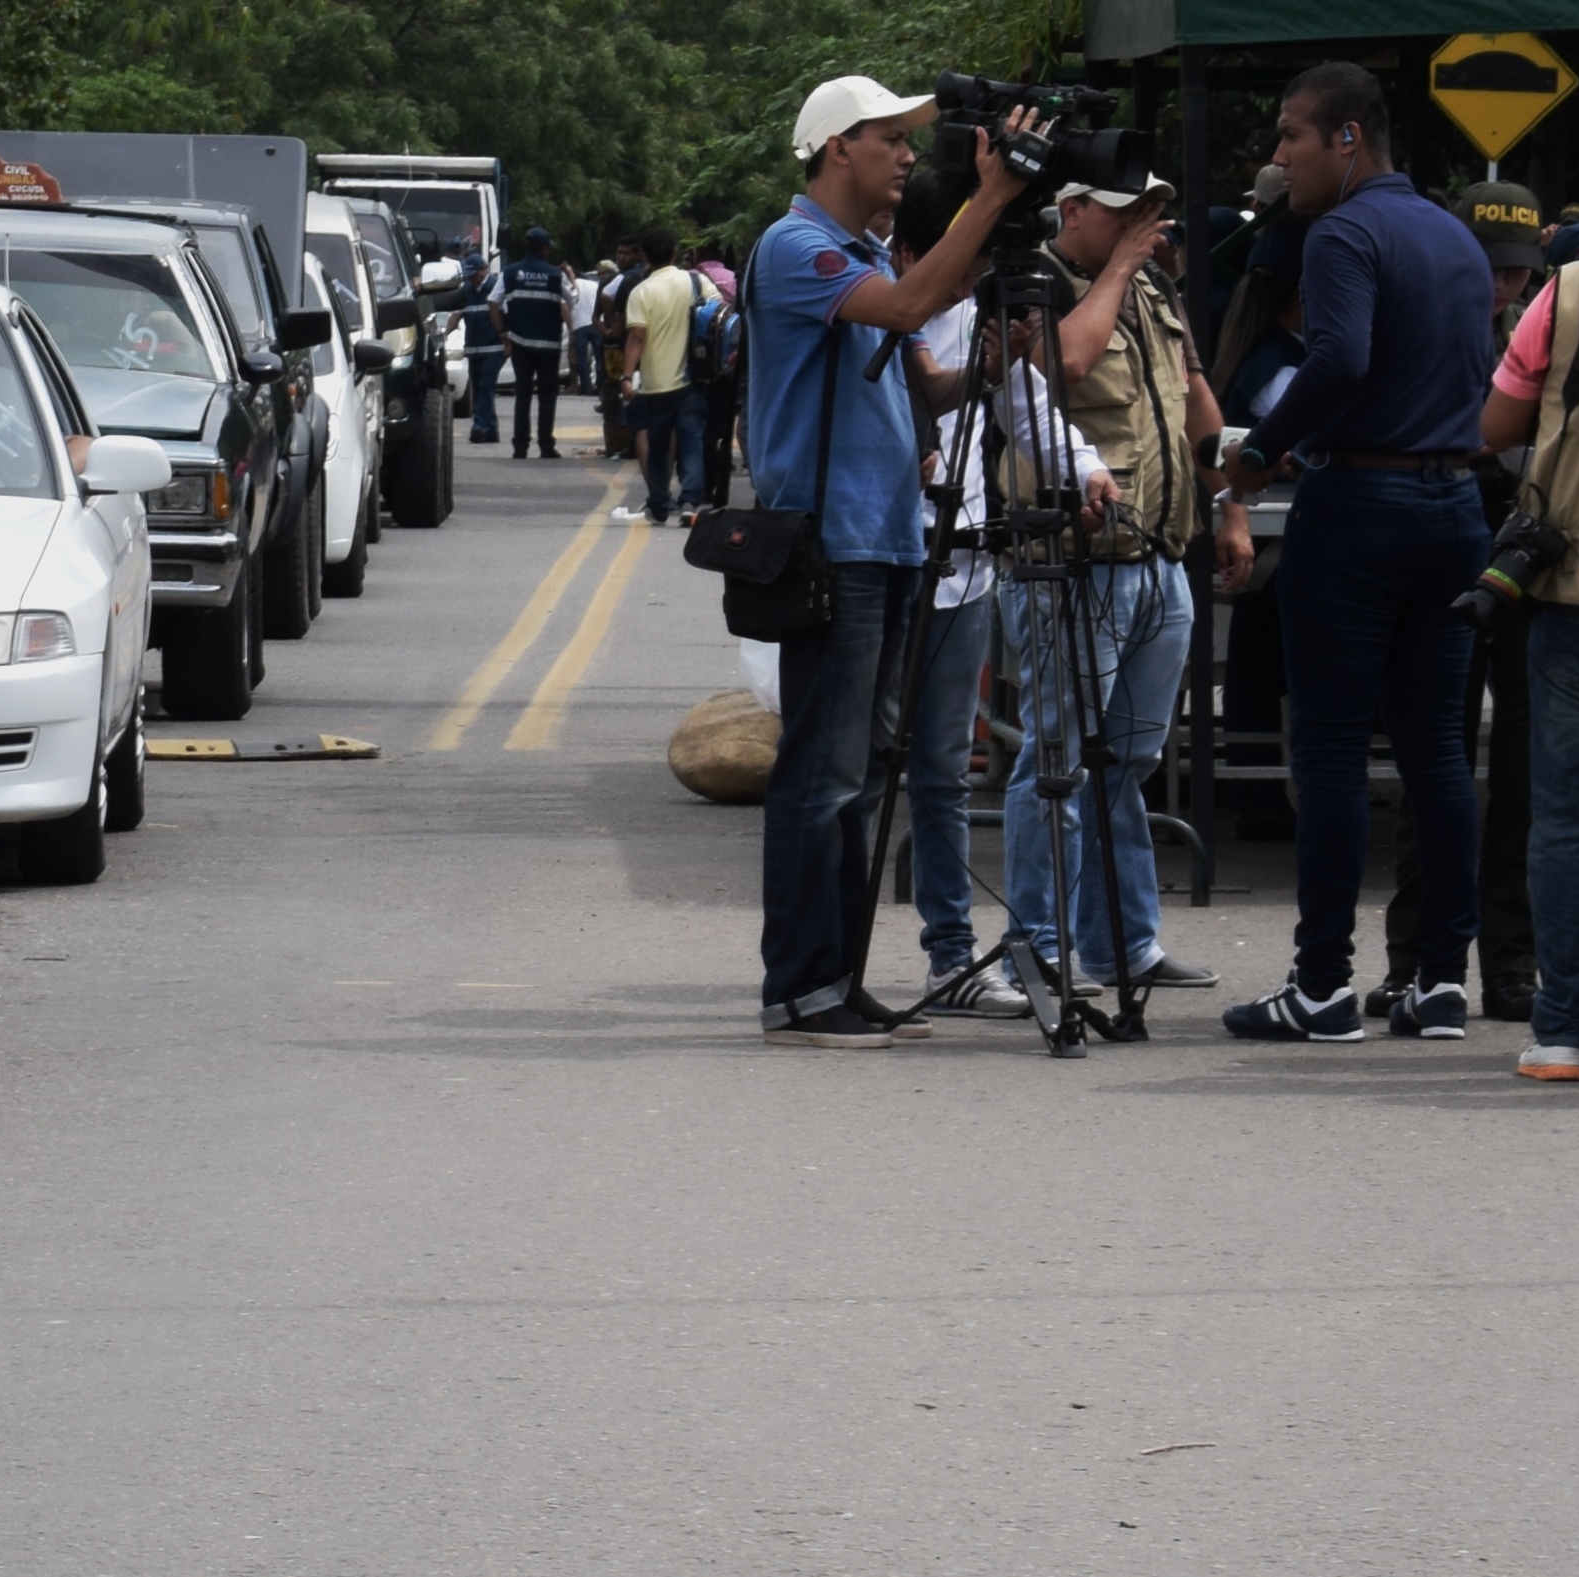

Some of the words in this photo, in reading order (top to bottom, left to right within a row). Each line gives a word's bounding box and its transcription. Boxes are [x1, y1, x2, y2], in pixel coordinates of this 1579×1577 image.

[5, 165, 30, 175] CIVIL
[9, 185, 45, 193] CUCUTA
[1474, 204, 1540, 227] POLICIA
